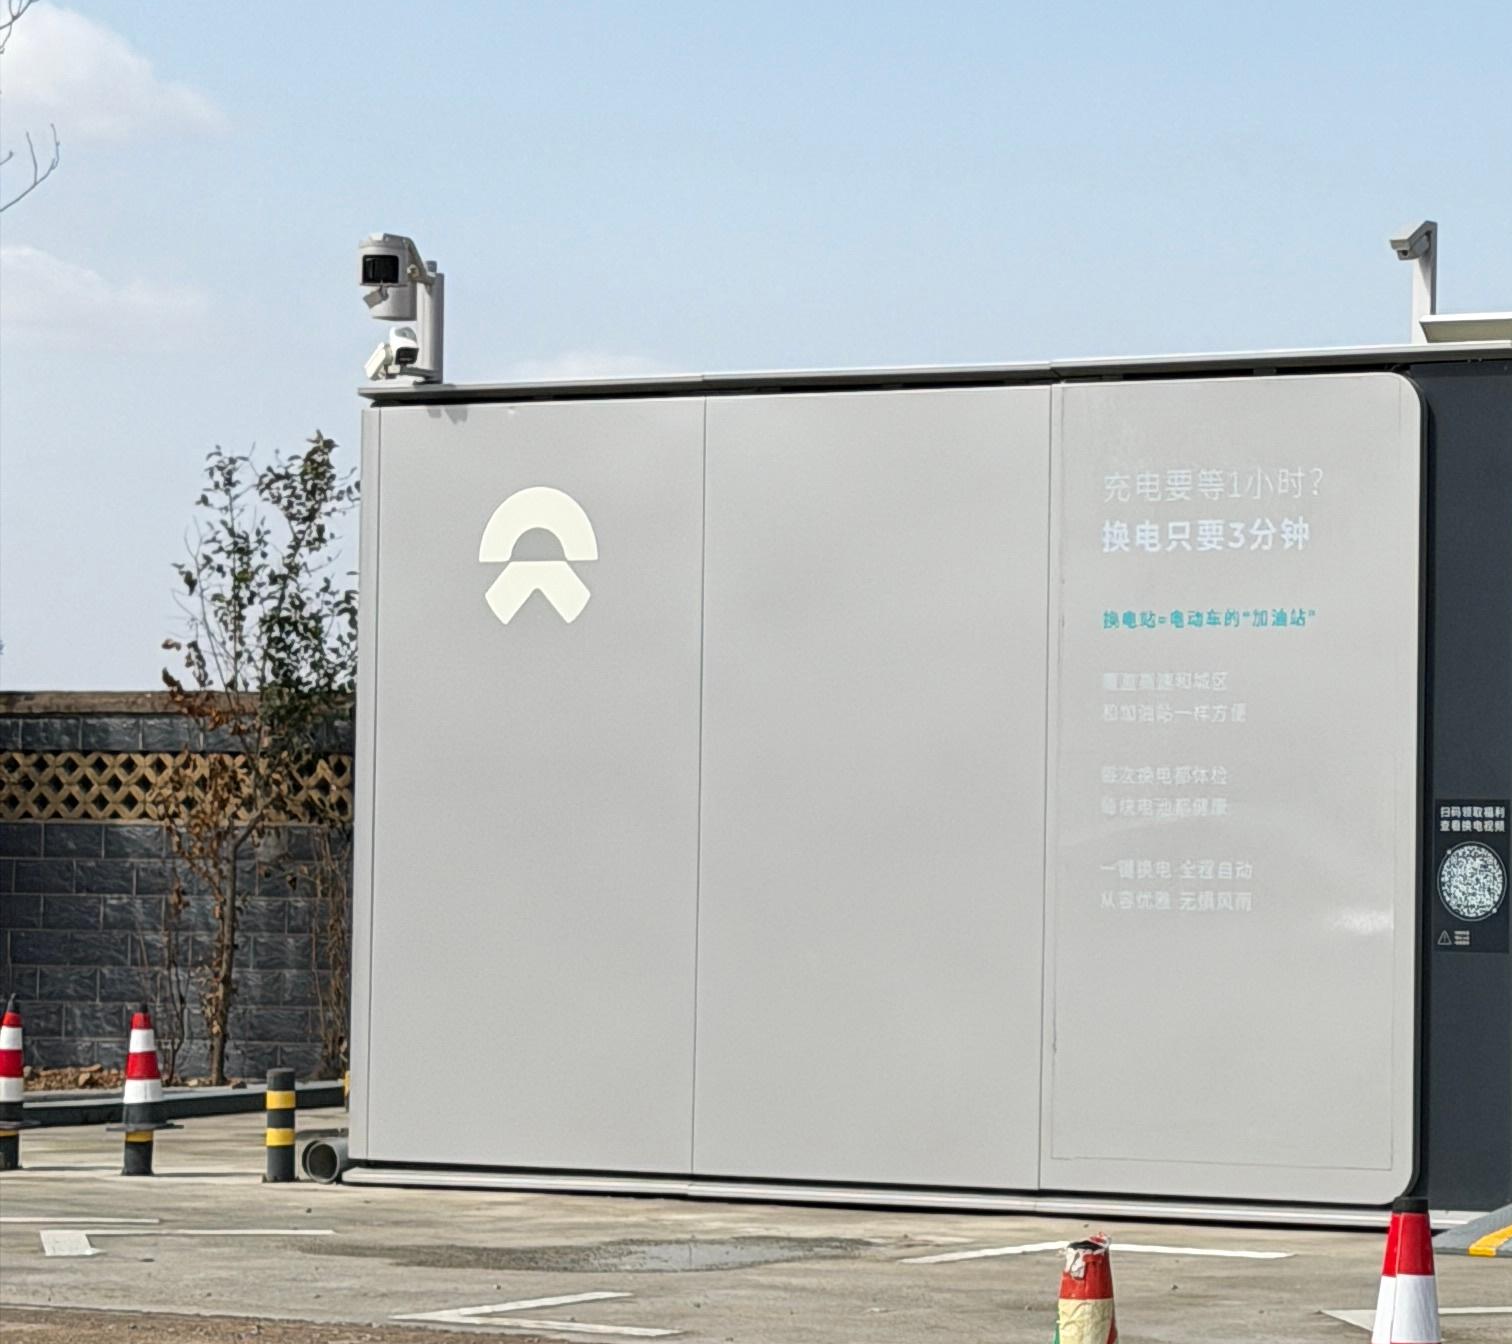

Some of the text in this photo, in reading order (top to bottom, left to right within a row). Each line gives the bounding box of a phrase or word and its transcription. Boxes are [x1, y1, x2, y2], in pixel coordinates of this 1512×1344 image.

[1101, 516, 1311, 554] 换电只要3分钟
